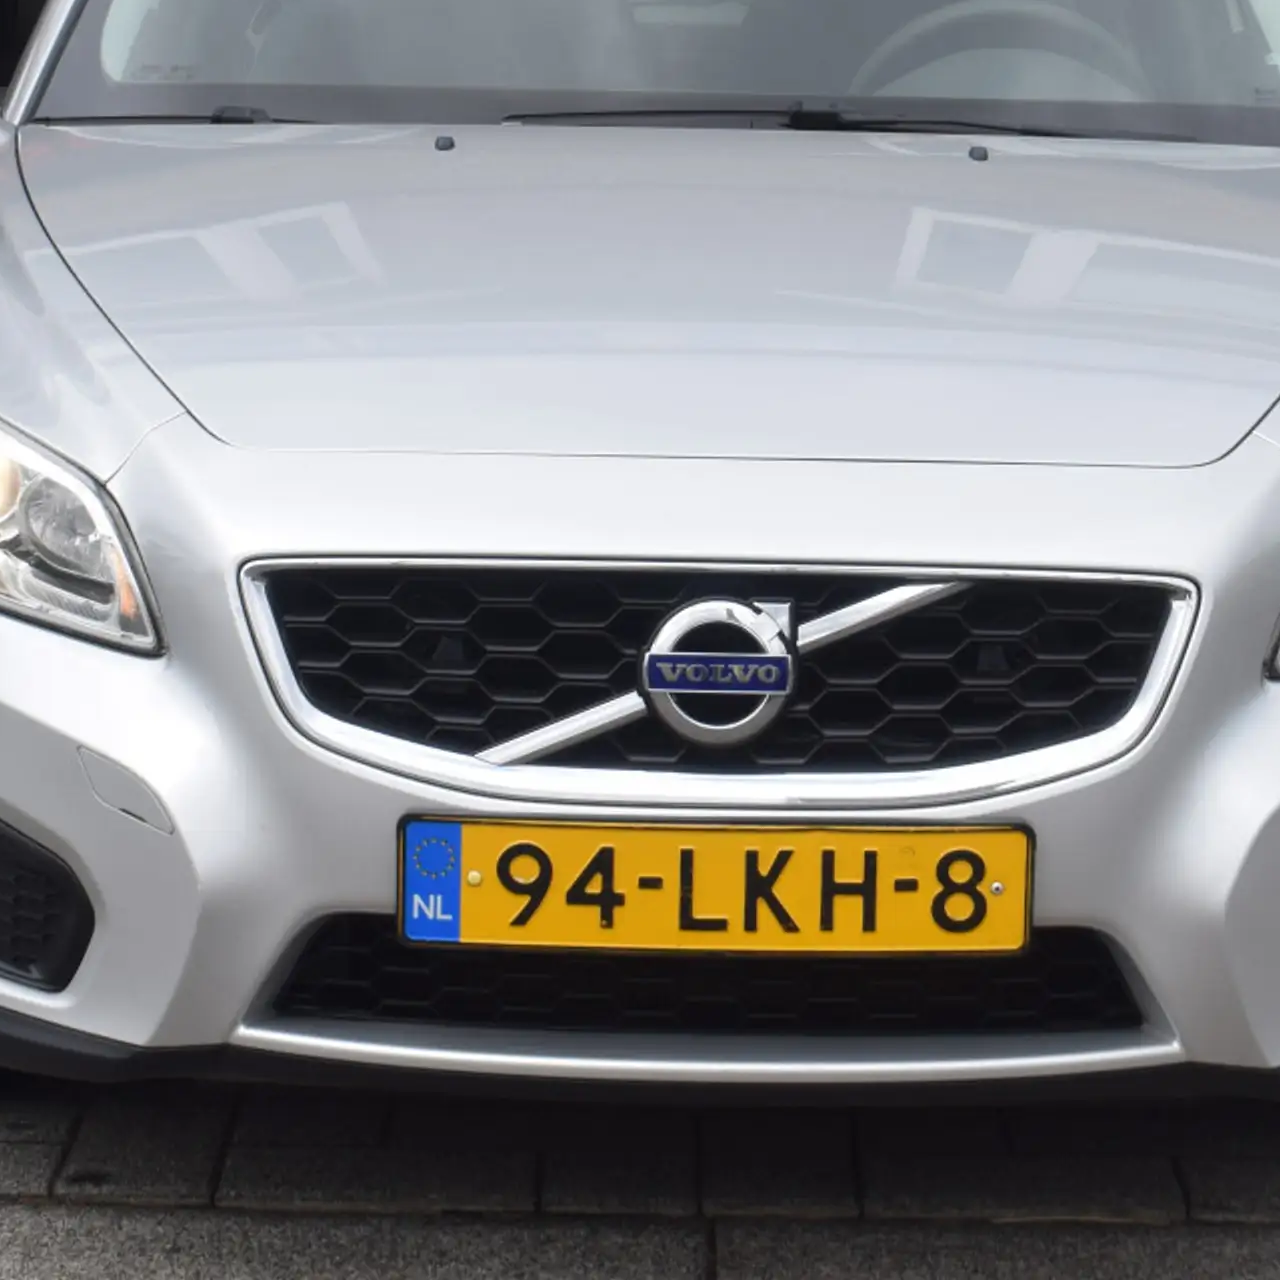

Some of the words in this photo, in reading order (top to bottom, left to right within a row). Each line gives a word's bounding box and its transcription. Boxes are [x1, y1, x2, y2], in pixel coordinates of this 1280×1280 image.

[655, 661, 781, 684] VOLVO
[496, 843, 988, 934] 94-LKH-8
[412, 894, 452, 920] NL
